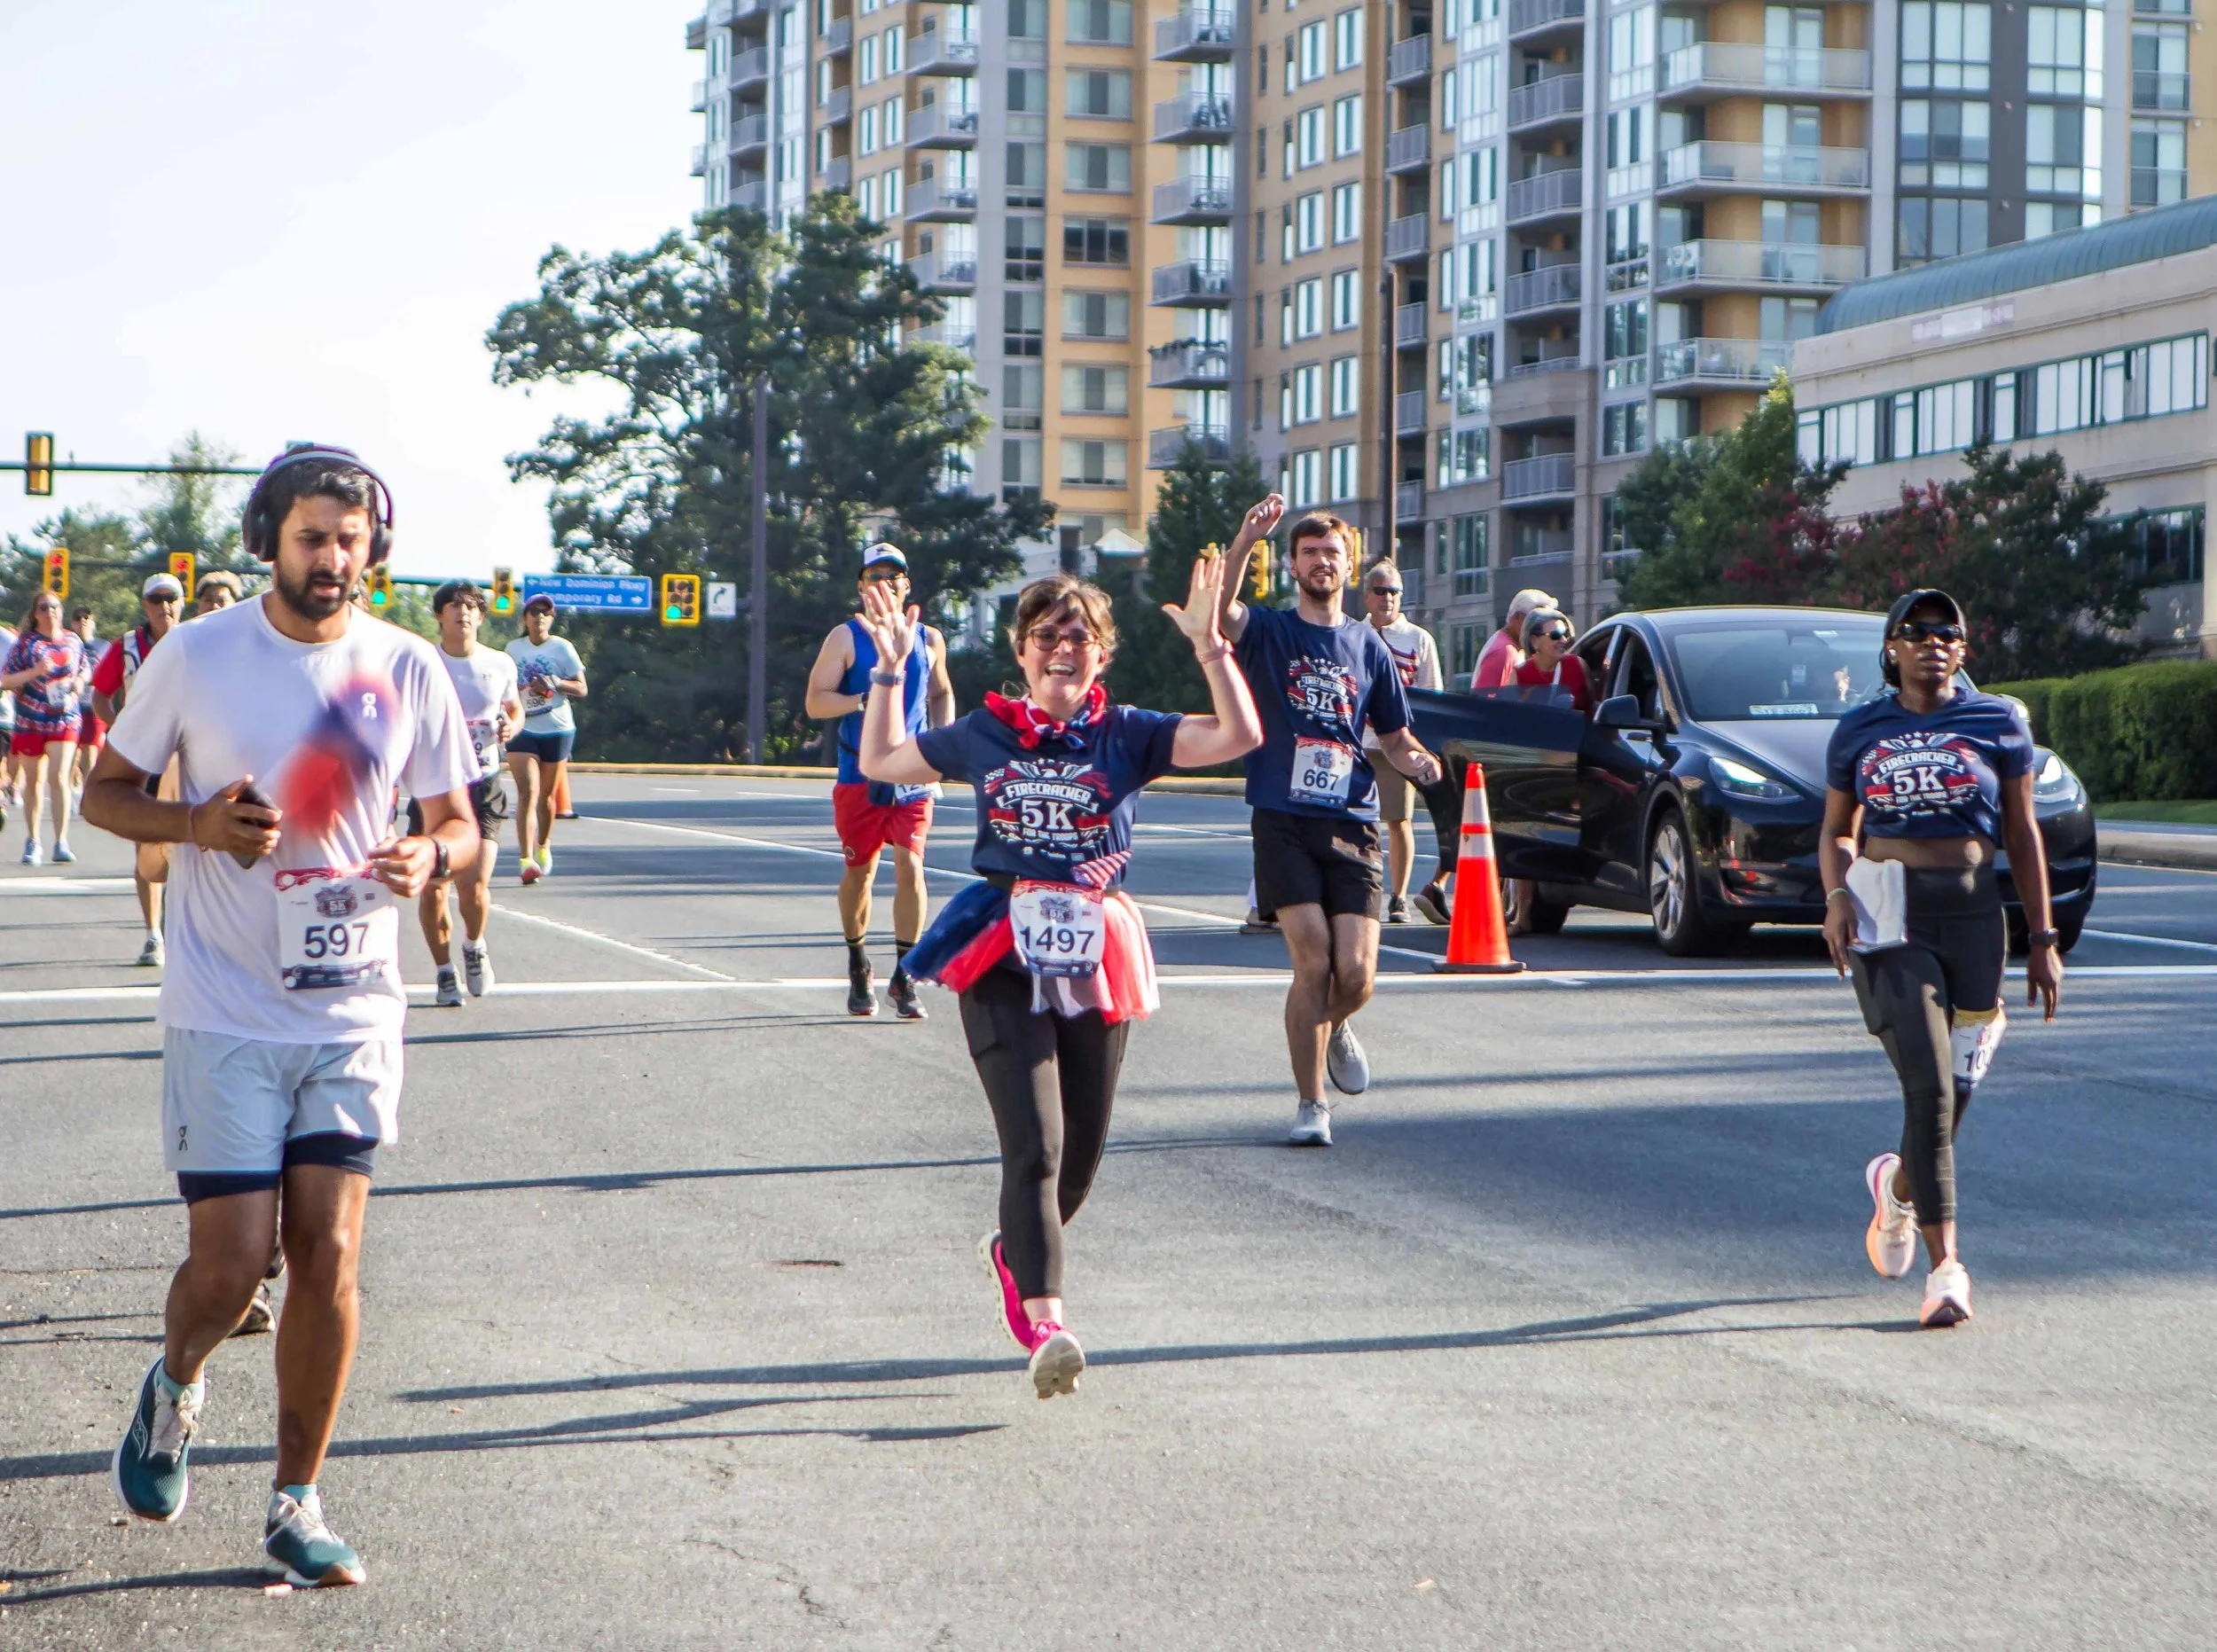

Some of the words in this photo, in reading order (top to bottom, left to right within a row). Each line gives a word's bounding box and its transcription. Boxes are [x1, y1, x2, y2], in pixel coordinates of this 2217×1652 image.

[566, 578, 615, 588] Dominion
[542, 591, 601, 604] emporary
[607, 593, 623, 604] Rd
[1306, 686, 1337, 712] 5K
[1879, 752, 1956, 773] FIRECRACKER
[1304, 769, 1340, 791] 667
[1893, 765, 1945, 795] 5K
[1005, 782, 1092, 805] FIRECRACKER
[1022, 799, 1074, 830] 5K
[304, 922, 371, 959] 597
[1020, 926, 1095, 955] 1497
